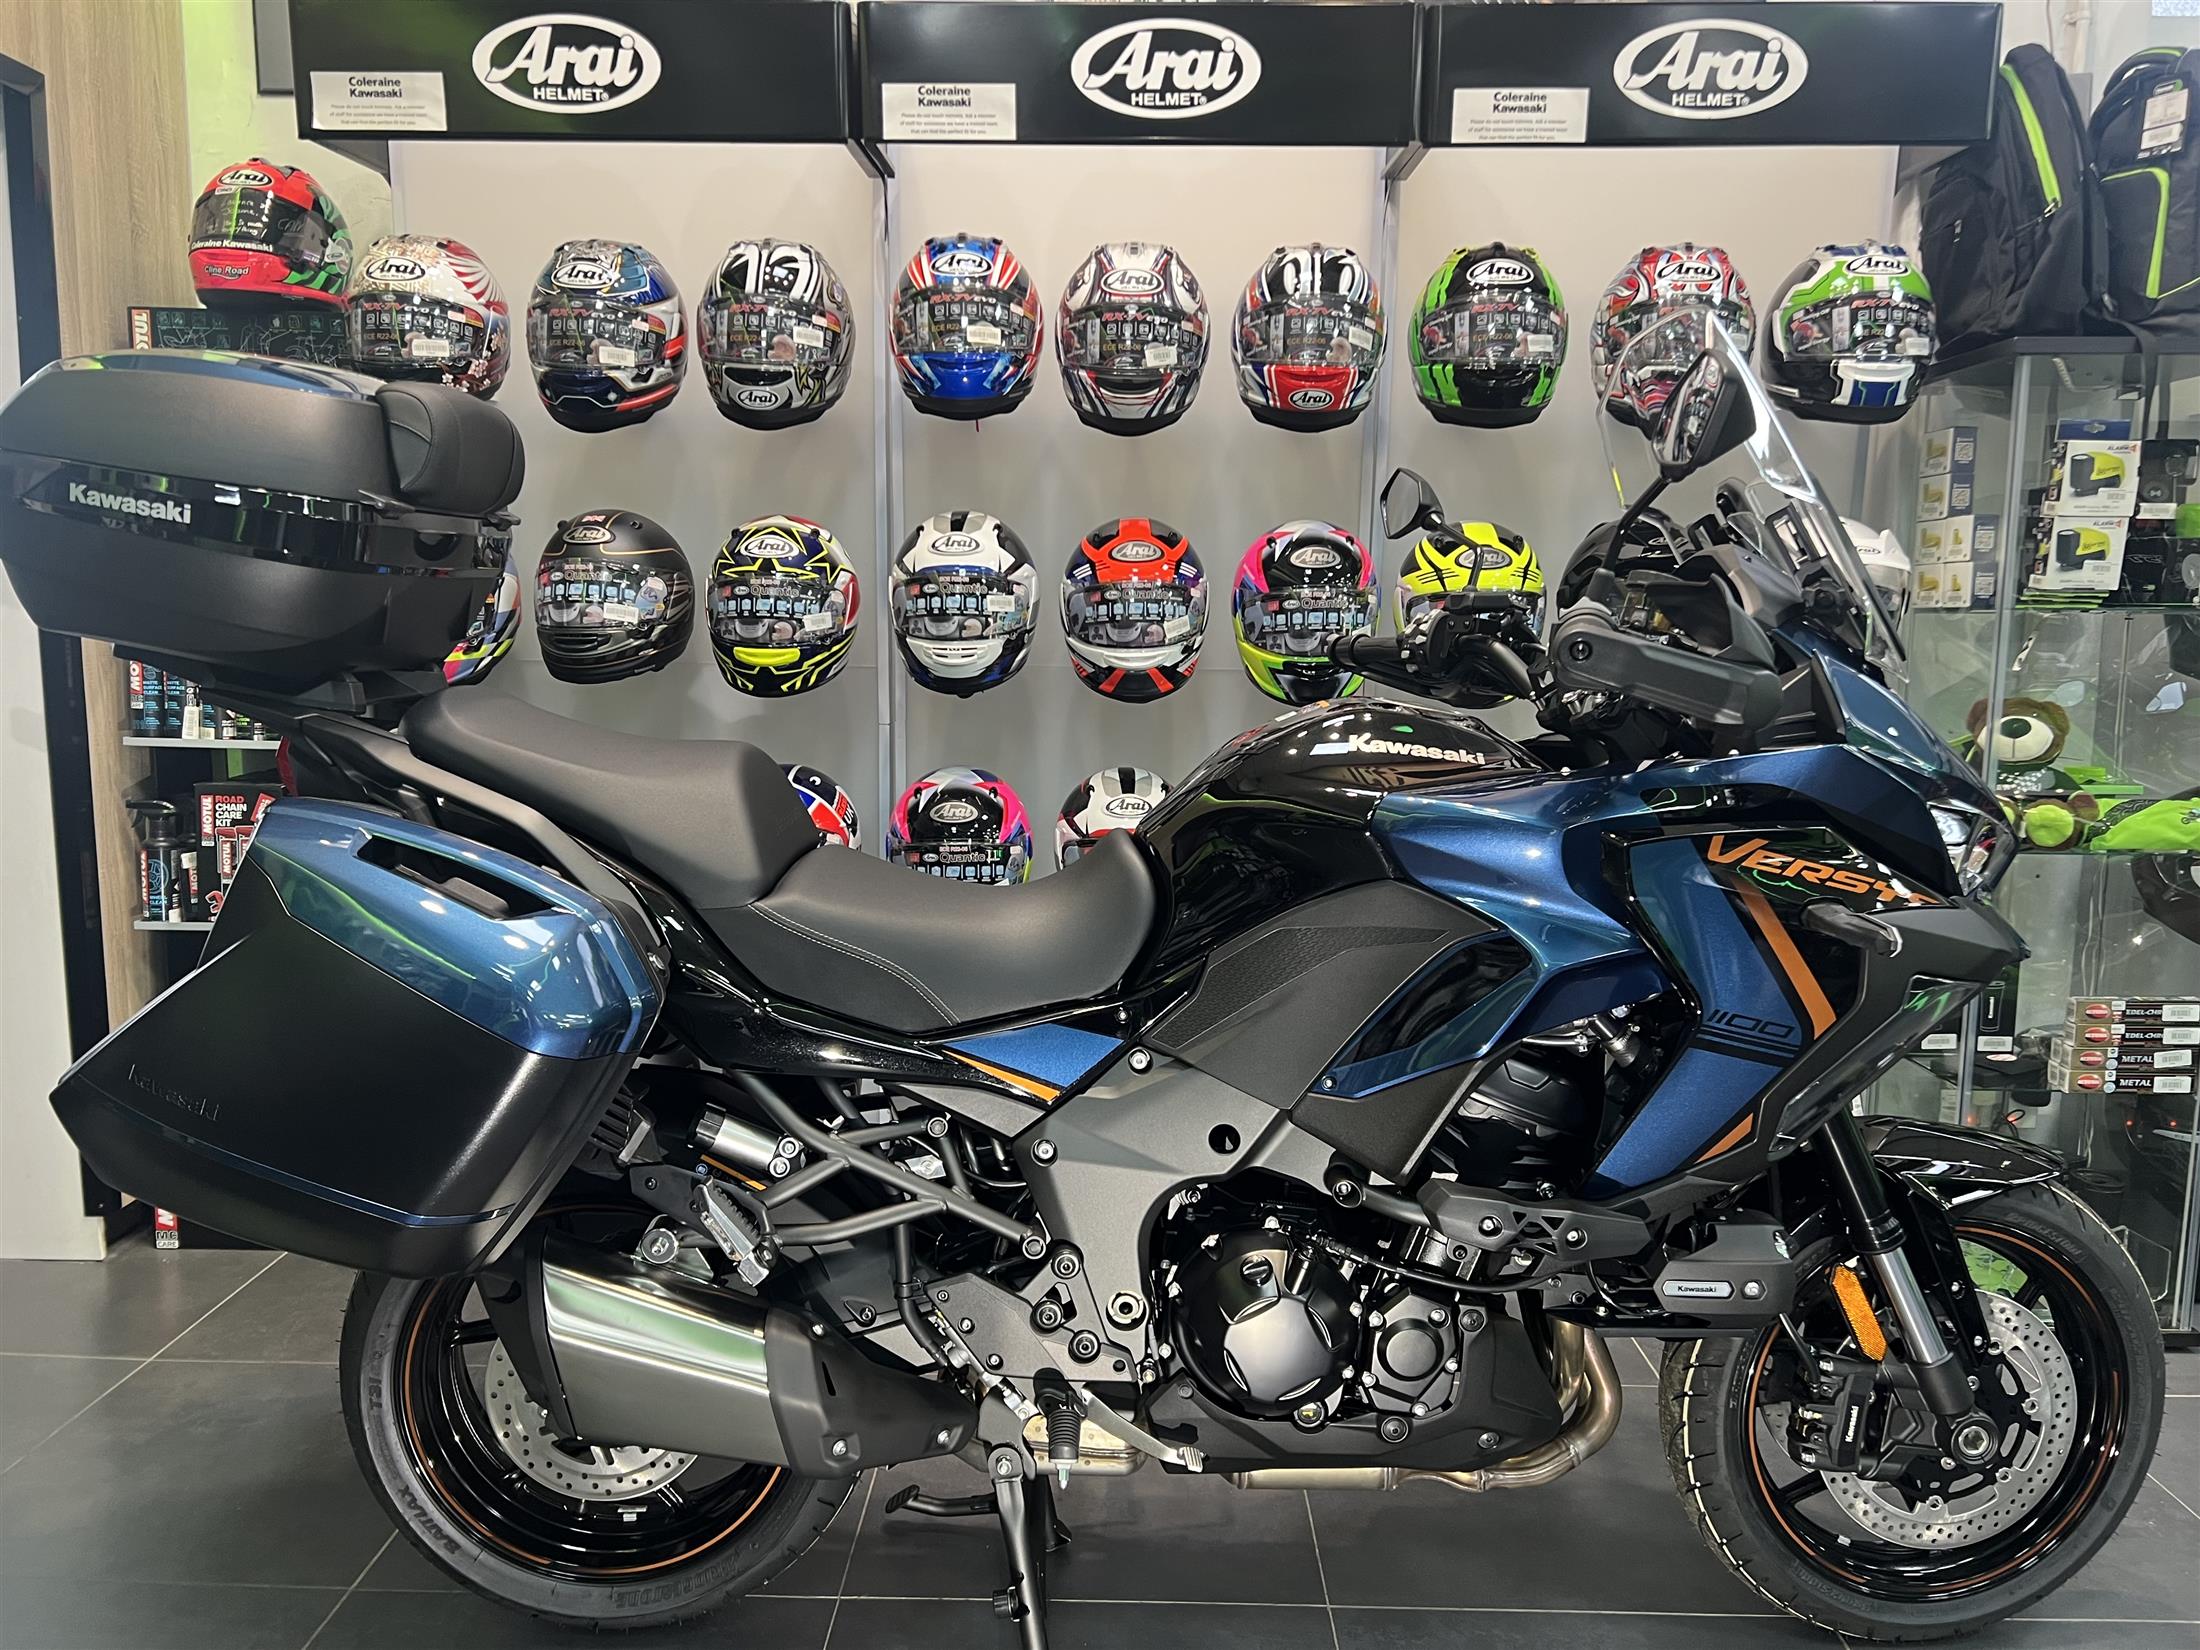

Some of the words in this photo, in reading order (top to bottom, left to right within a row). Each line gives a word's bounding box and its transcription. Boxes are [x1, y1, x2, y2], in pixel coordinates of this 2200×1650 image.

[485, 24, 639, 87] Arai
[1083, 31, 1238, 91] Arai
[1623, 31, 1784, 91] Arai
[348, 76, 401, 87] Coleraine
[349, 88, 403, 98] Kawasaki
[533, 87, 604, 102] HELMET
[918, 85, 971, 96] Coleraine
[1493, 91, 1547, 102] Coleraine
[918, 96, 972, 107] Kawasaki
[1131, 93, 1201, 106] HELMET
[1672, 93, 1744, 107] HELMET
[1492, 103, 1547, 114] Kawasaki
[221, 169, 269, 182] Arai
[222, 240, 273, 253] Kawasaki
[368, 259, 421, 276] Arai
[936, 253, 984, 269] Arai
[1848, 257, 1903, 272] Arai
[1472, 262, 1525, 278] Arai
[1658, 262, 1714, 278] Arai
[1107, 271, 1155, 286] Arai
[1517, 305, 1539, 314] eo
[134, 312, 149, 350] OTUL
[741, 391, 773, 403] Arai
[1292, 391, 1329, 404] Arai
[69, 482, 191, 524] Kawasaki
[567, 528, 604, 539] Arai
[746, 539, 787, 551] Arai
[938, 537, 973, 549] Arai
[1117, 542, 1156, 555] Arai
[1299, 550, 1336, 563] Arai
[750, 584, 800, 597] Quantic
[1348, 732, 1486, 765] Kawasaki
[215, 795, 245, 803] ROAD
[1109, 799, 1146, 811] Arai
[215, 803, 248, 811] CHAIN
[936, 804, 973, 818] Arai
[202, 797, 213, 835] MOTUL
[215, 811, 243, 819] CARE
[843, 804, 855, 824] UK
[215, 819, 233, 827] KIT
[222, 842, 231, 874] MOTUL
[940, 852, 986, 863] Quantic
[1706, 1009, 1796, 1039] 1100
[2121, 1055, 2154, 1063] METAL
[2119, 1079, 2152, 1087] METAL
[156, 1231, 177, 1239] MC
[1677, 1285, 1717, 1293] Kawasaki
[398, 1484, 463, 1555] BATTLAX
